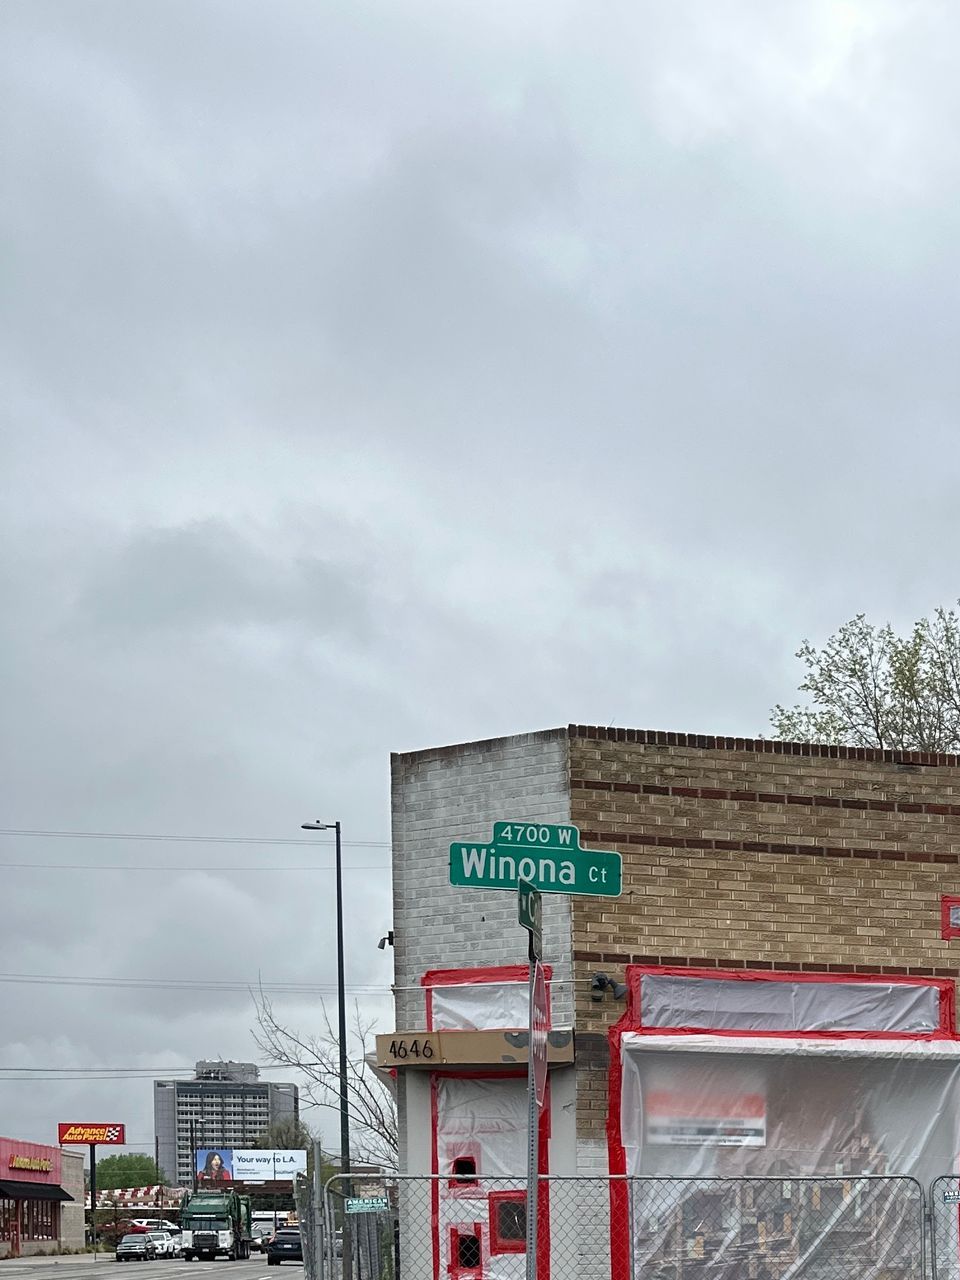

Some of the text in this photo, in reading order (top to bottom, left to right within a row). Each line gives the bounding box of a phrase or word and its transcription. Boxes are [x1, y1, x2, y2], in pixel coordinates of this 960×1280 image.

[500, 825, 571, 845] 4700 W
[461, 847, 607, 885] Winona Ct
[389, 1039, 433, 1059] 4646
[62, 1133, 83, 1141] Auto
[67, 1126, 106, 1135] Advance
[255, 1157, 272, 1165] way
